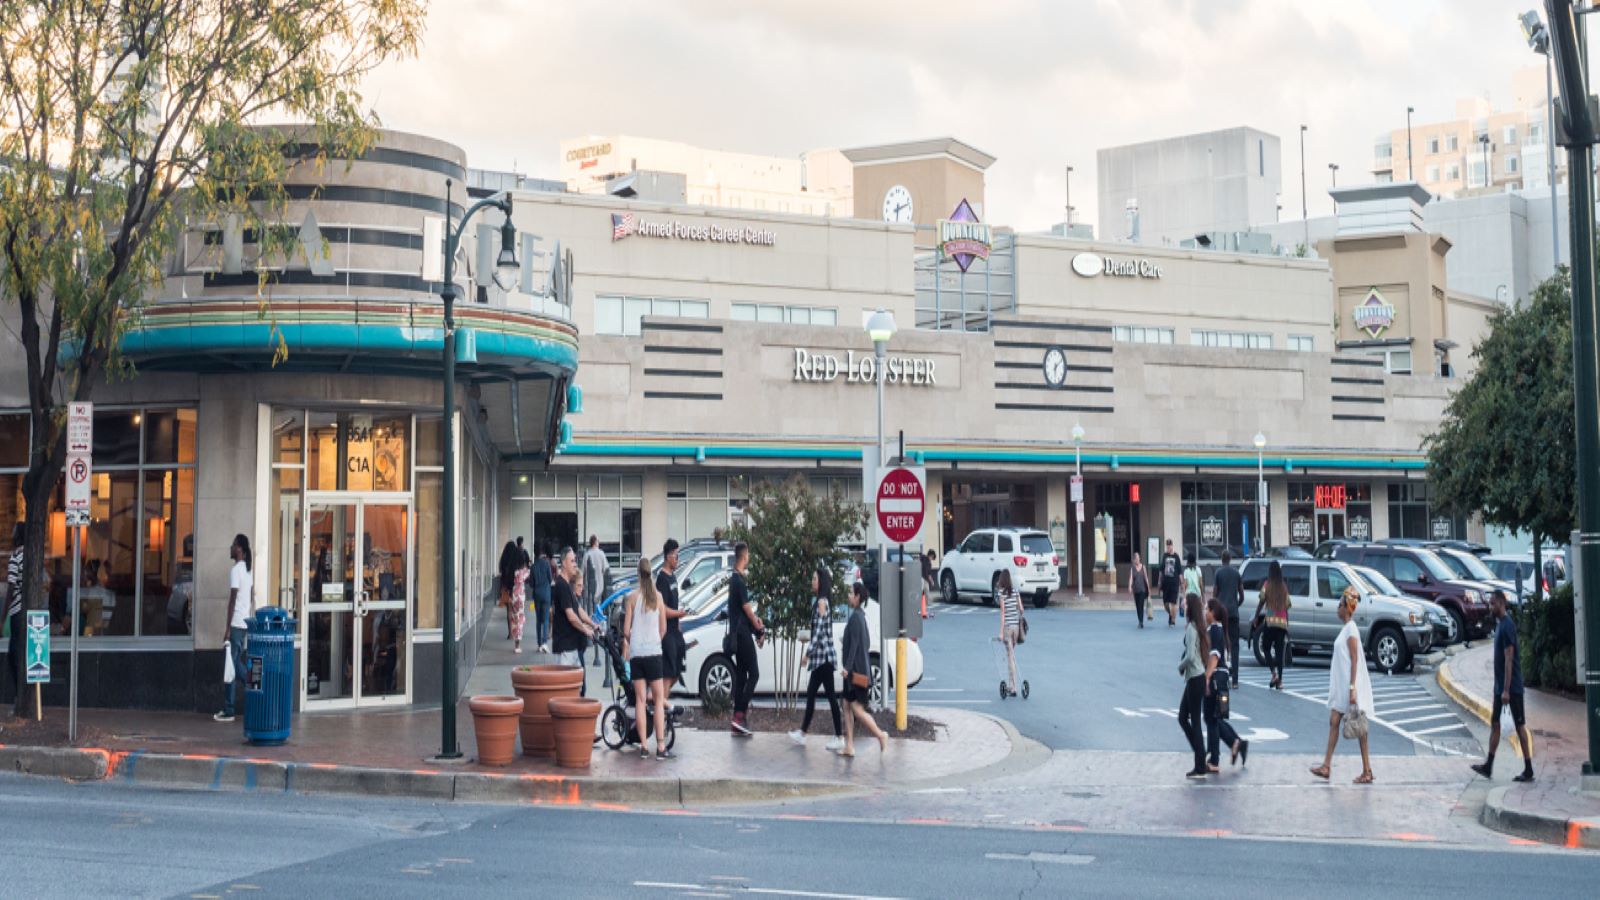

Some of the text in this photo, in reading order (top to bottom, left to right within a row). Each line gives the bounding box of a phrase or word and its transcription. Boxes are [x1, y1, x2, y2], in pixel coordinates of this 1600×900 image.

[638, 218, 776, 245] Armed Forces Career Center
[1104, 257, 1164, 278] Dental Care
[794, 347, 840, 381] RED
[347, 456, 370, 473] C1A
[883, 482, 918, 495] DO NOT
[886, 515, 915, 529] ENTER
